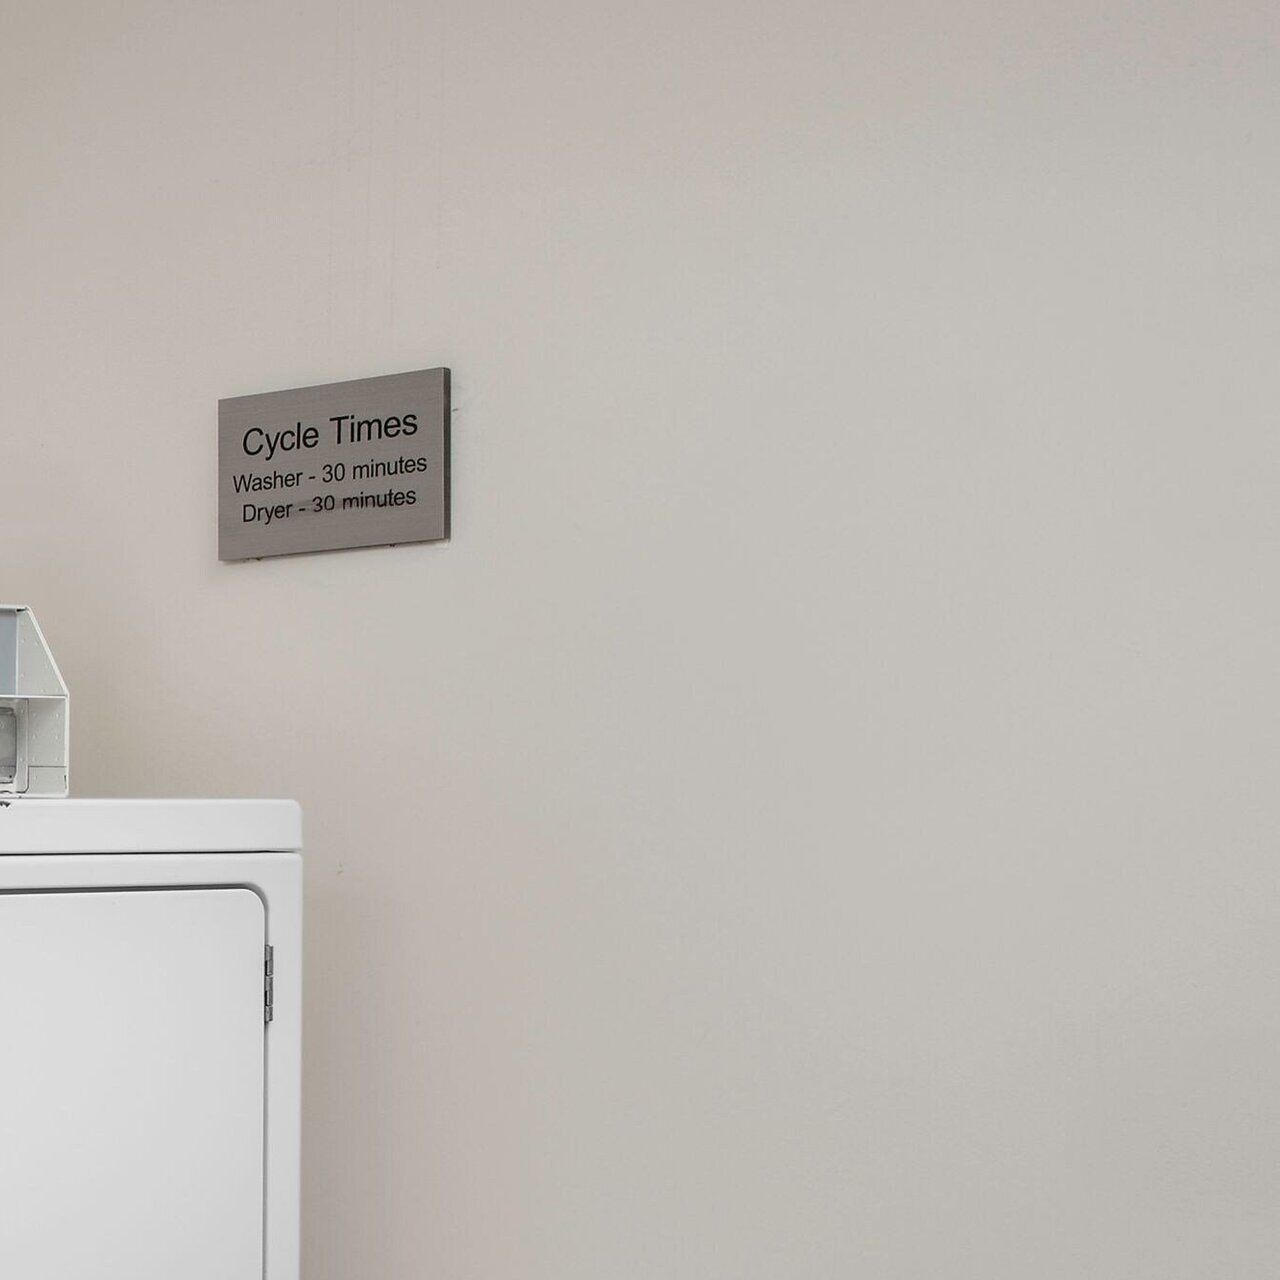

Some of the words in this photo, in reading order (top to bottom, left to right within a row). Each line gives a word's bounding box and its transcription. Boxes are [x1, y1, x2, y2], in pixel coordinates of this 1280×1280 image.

[242, 421, 320, 461] Cycle
[329, 413, 418, 445] Times
[232, 470, 304, 493] Washer
[322, 462, 346, 483] 30
[352, 455, 428, 480] minutes
[242, 502, 293, 525] Dryer
[311, 495, 335, 513] 30
[342, 488, 417, 510] minutes
